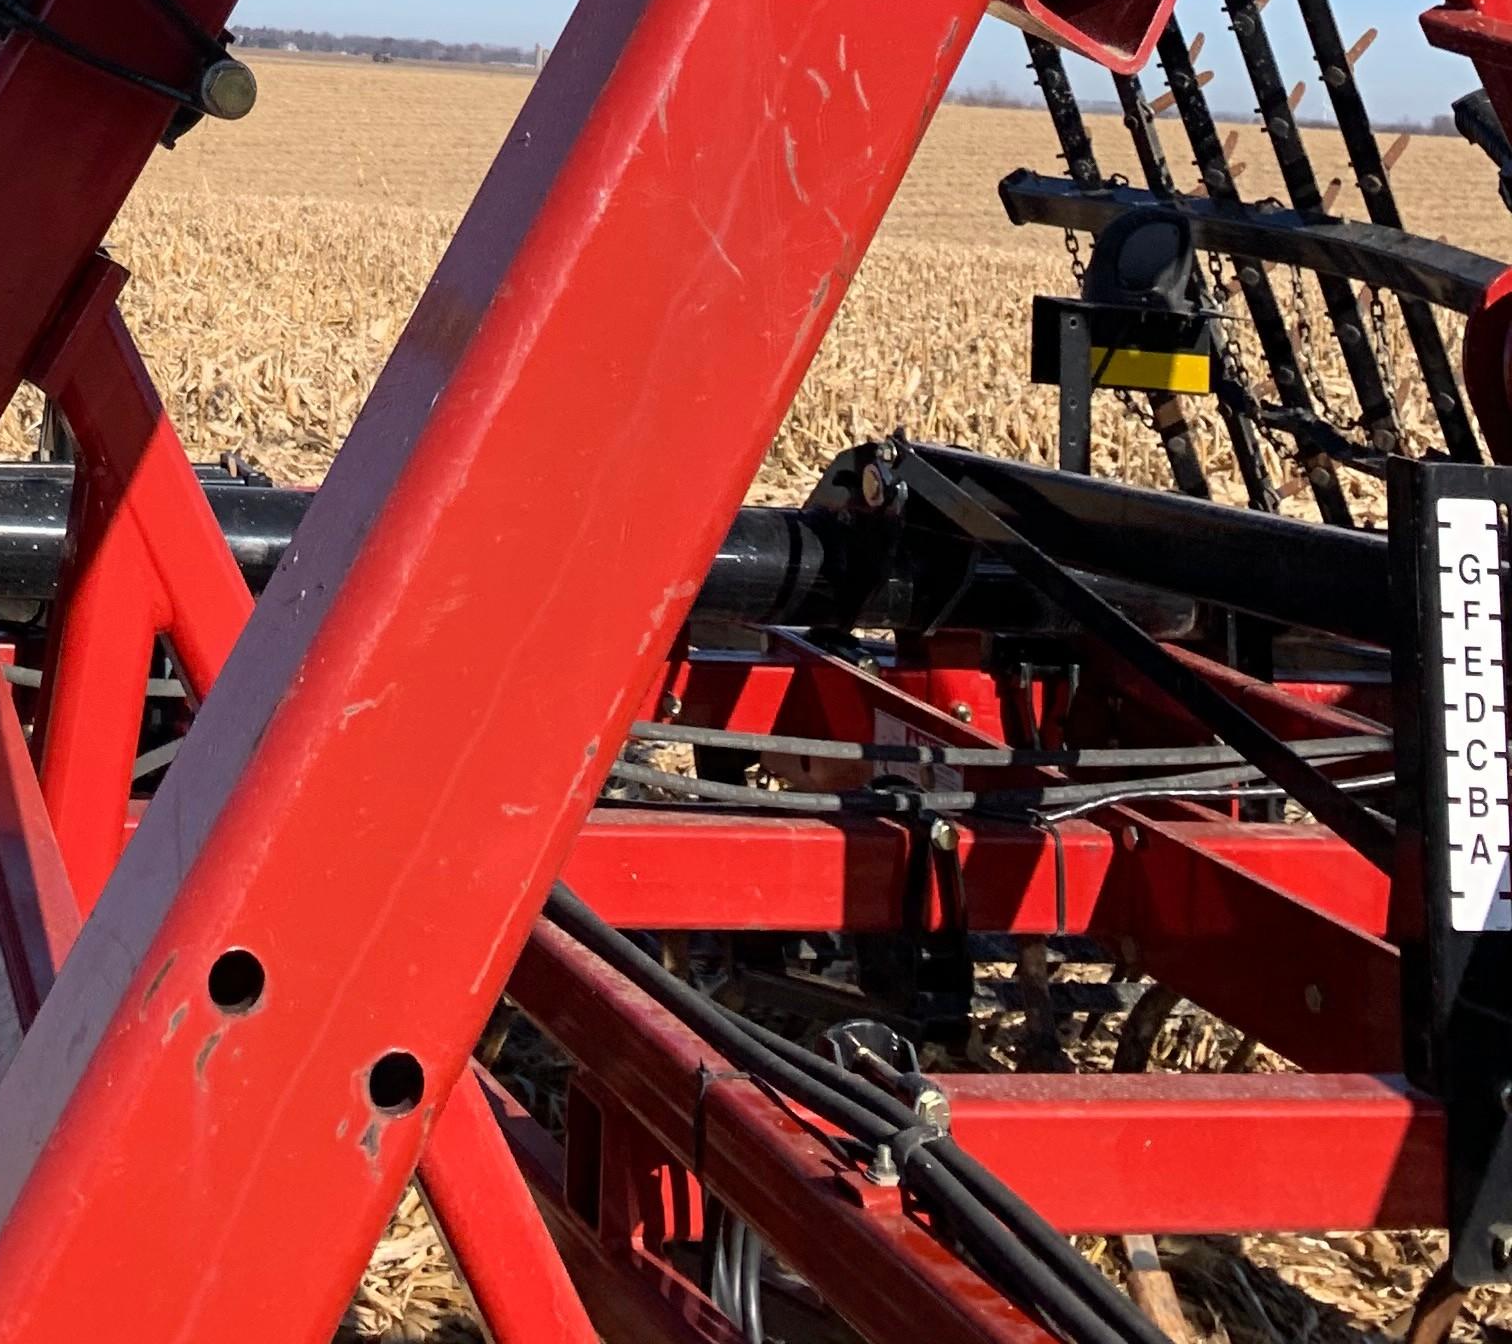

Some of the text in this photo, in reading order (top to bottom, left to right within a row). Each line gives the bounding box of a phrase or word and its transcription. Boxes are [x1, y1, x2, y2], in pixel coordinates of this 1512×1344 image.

[1458, 553, 1481, 585] G
[1463, 600, 1481, 630] F
[1464, 646, 1483, 677] E
[1465, 692, 1486, 723] D
[1466, 739, 1488, 771] C
[1468, 786, 1489, 818] B
[1470, 833, 1491, 865] A
